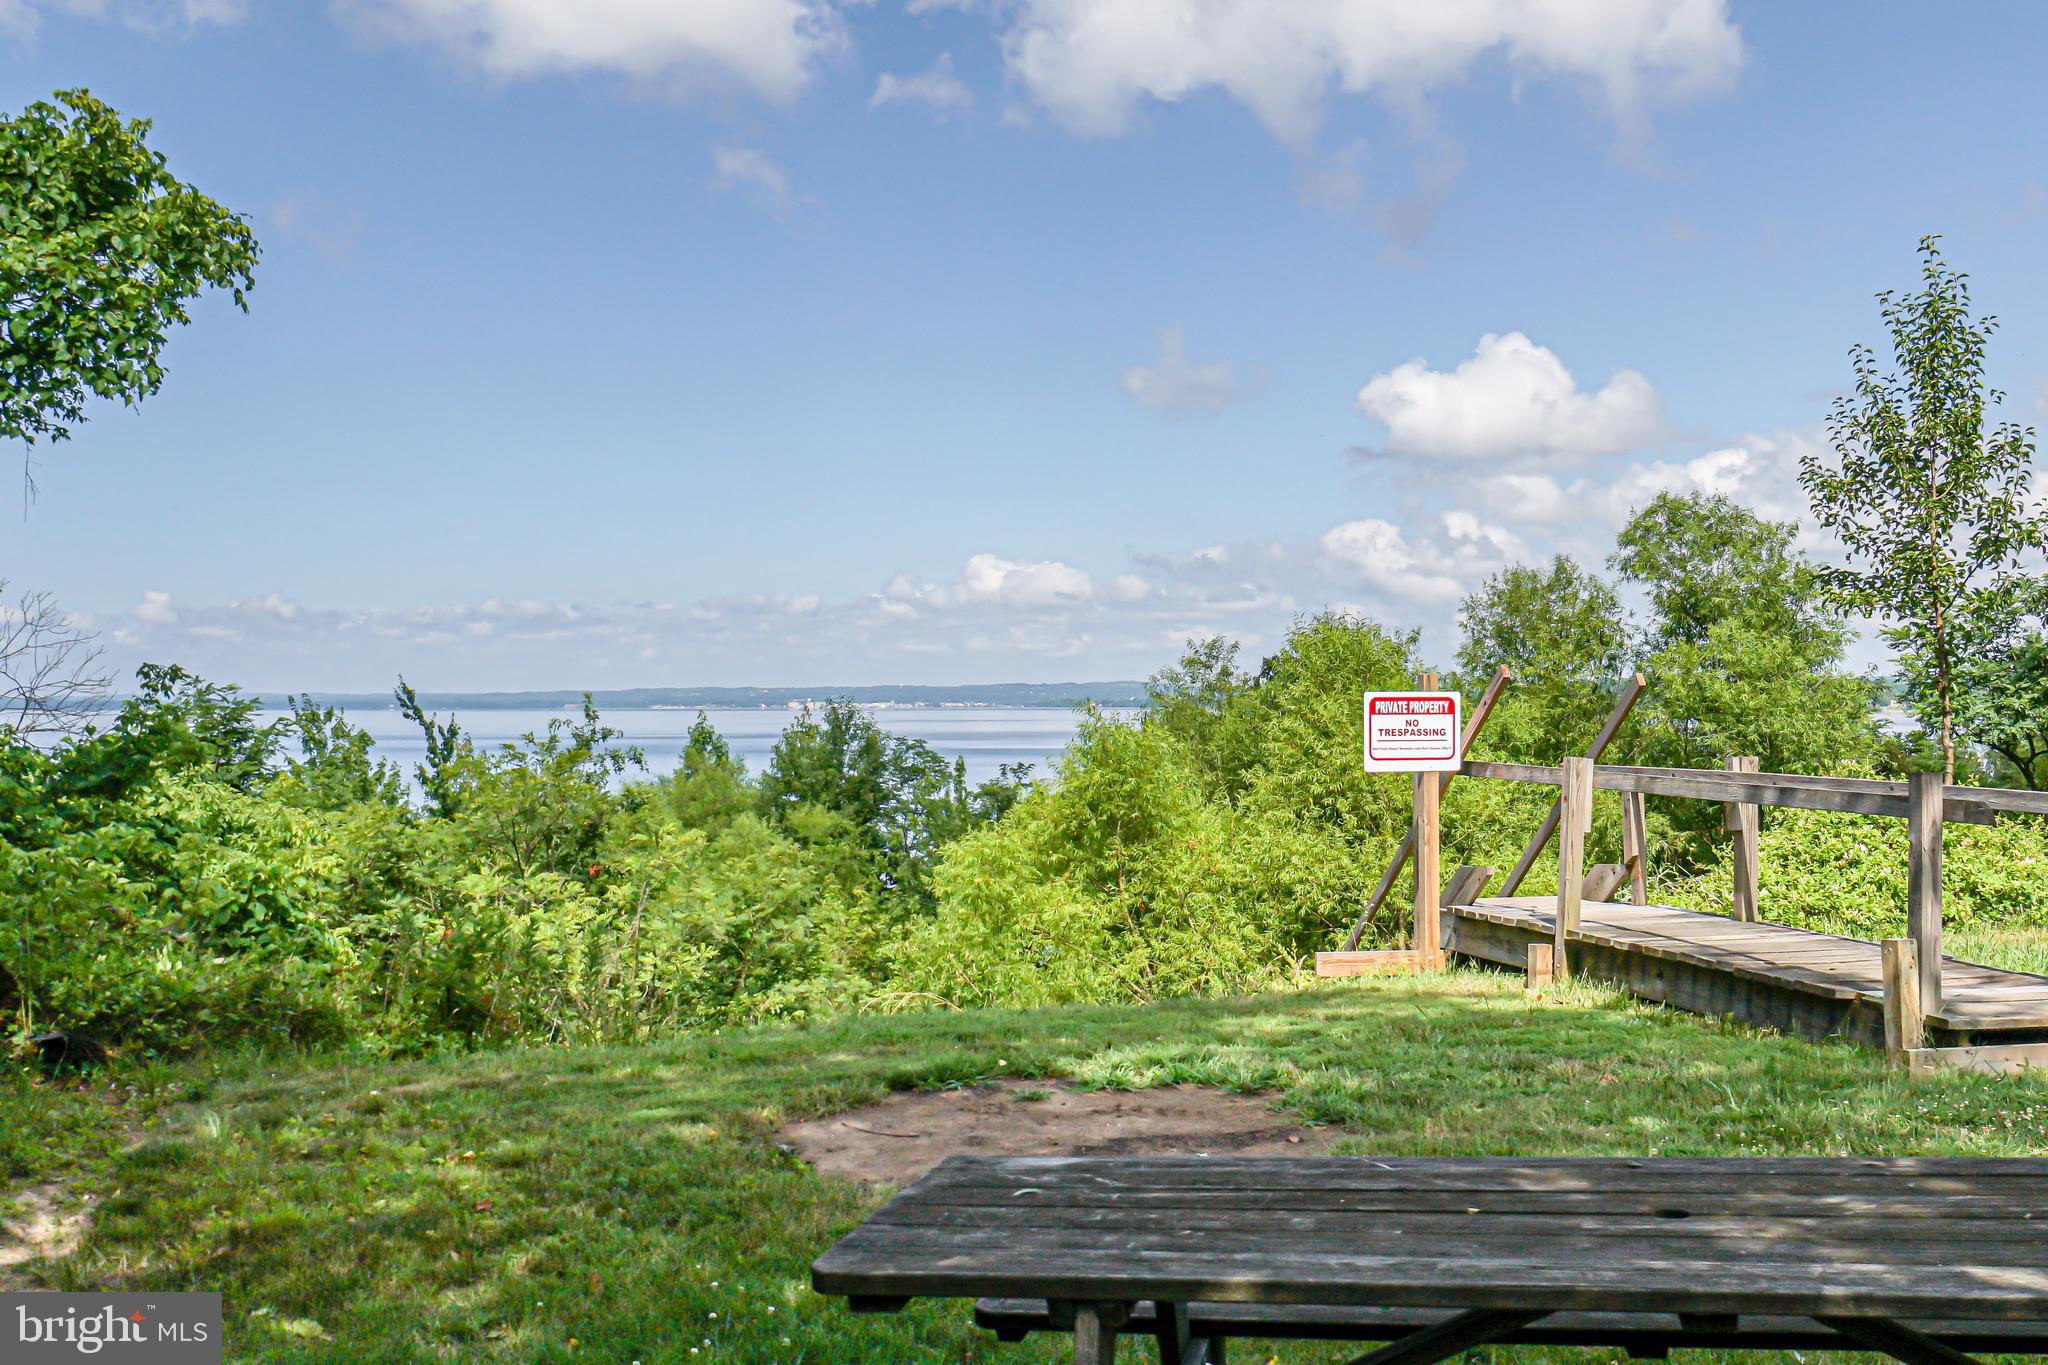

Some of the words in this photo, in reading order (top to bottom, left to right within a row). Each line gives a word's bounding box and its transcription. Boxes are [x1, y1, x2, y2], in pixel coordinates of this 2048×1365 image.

[1375, 701, 1408, 713] PRIVATE
[1409, 701, 1449, 713] PROPERTY
[1405, 719, 1419, 727] NO
[1378, 728, 1446, 736] TRESPASSING
